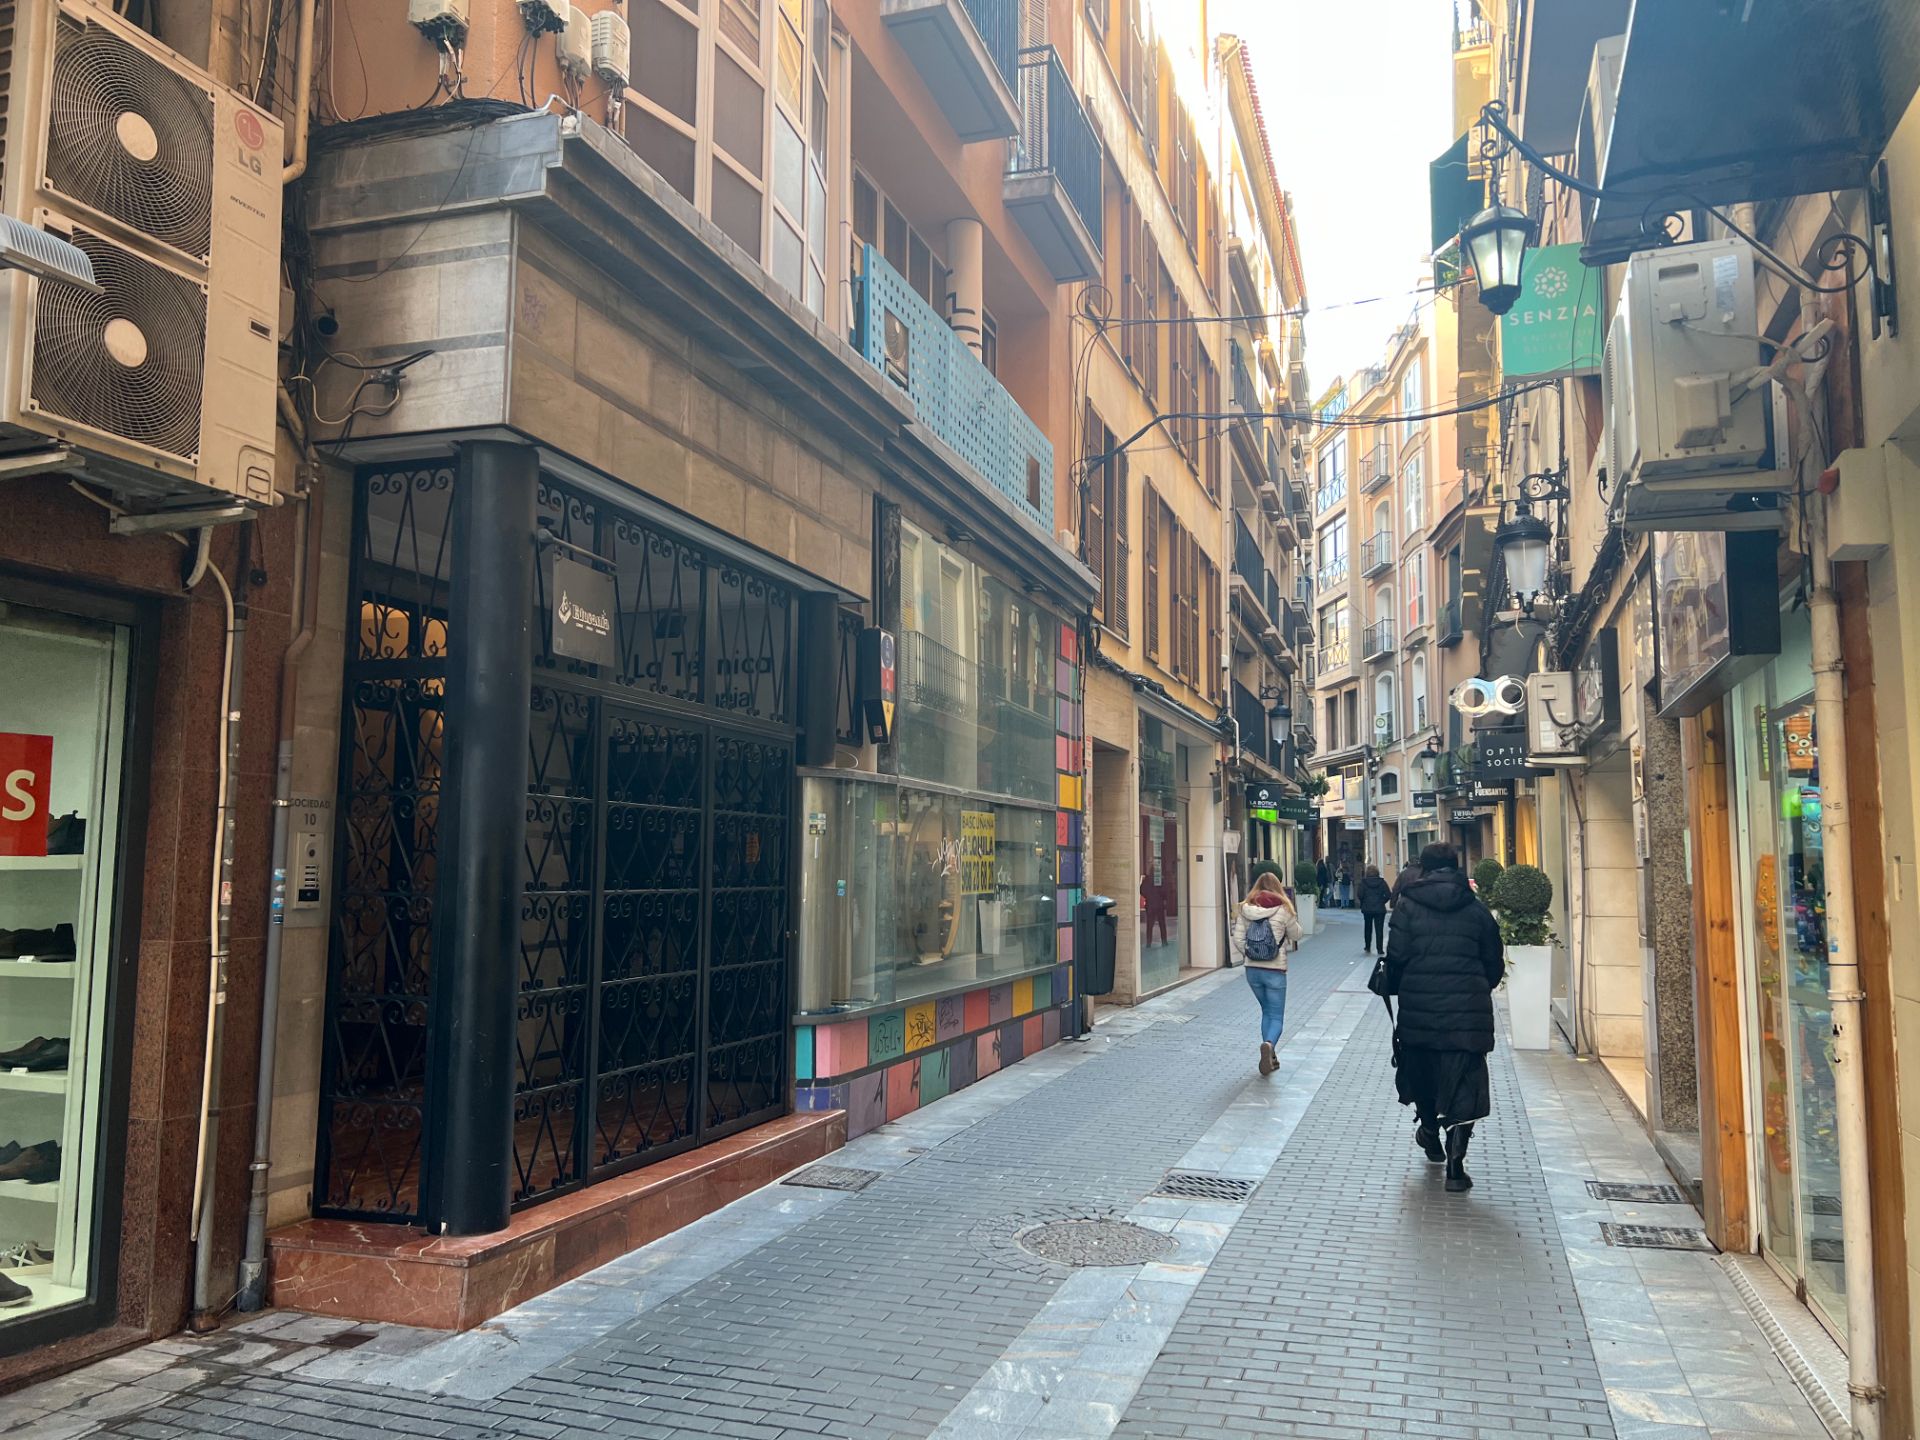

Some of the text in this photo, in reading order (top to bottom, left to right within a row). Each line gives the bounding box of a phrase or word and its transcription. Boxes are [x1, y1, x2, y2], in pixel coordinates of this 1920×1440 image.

[238, 147, 262, 176] LG
[230, 194, 266, 219] INVERTER
[1509, 304, 1596, 326] SENZIA
[304, 812, 317, 825] 10
